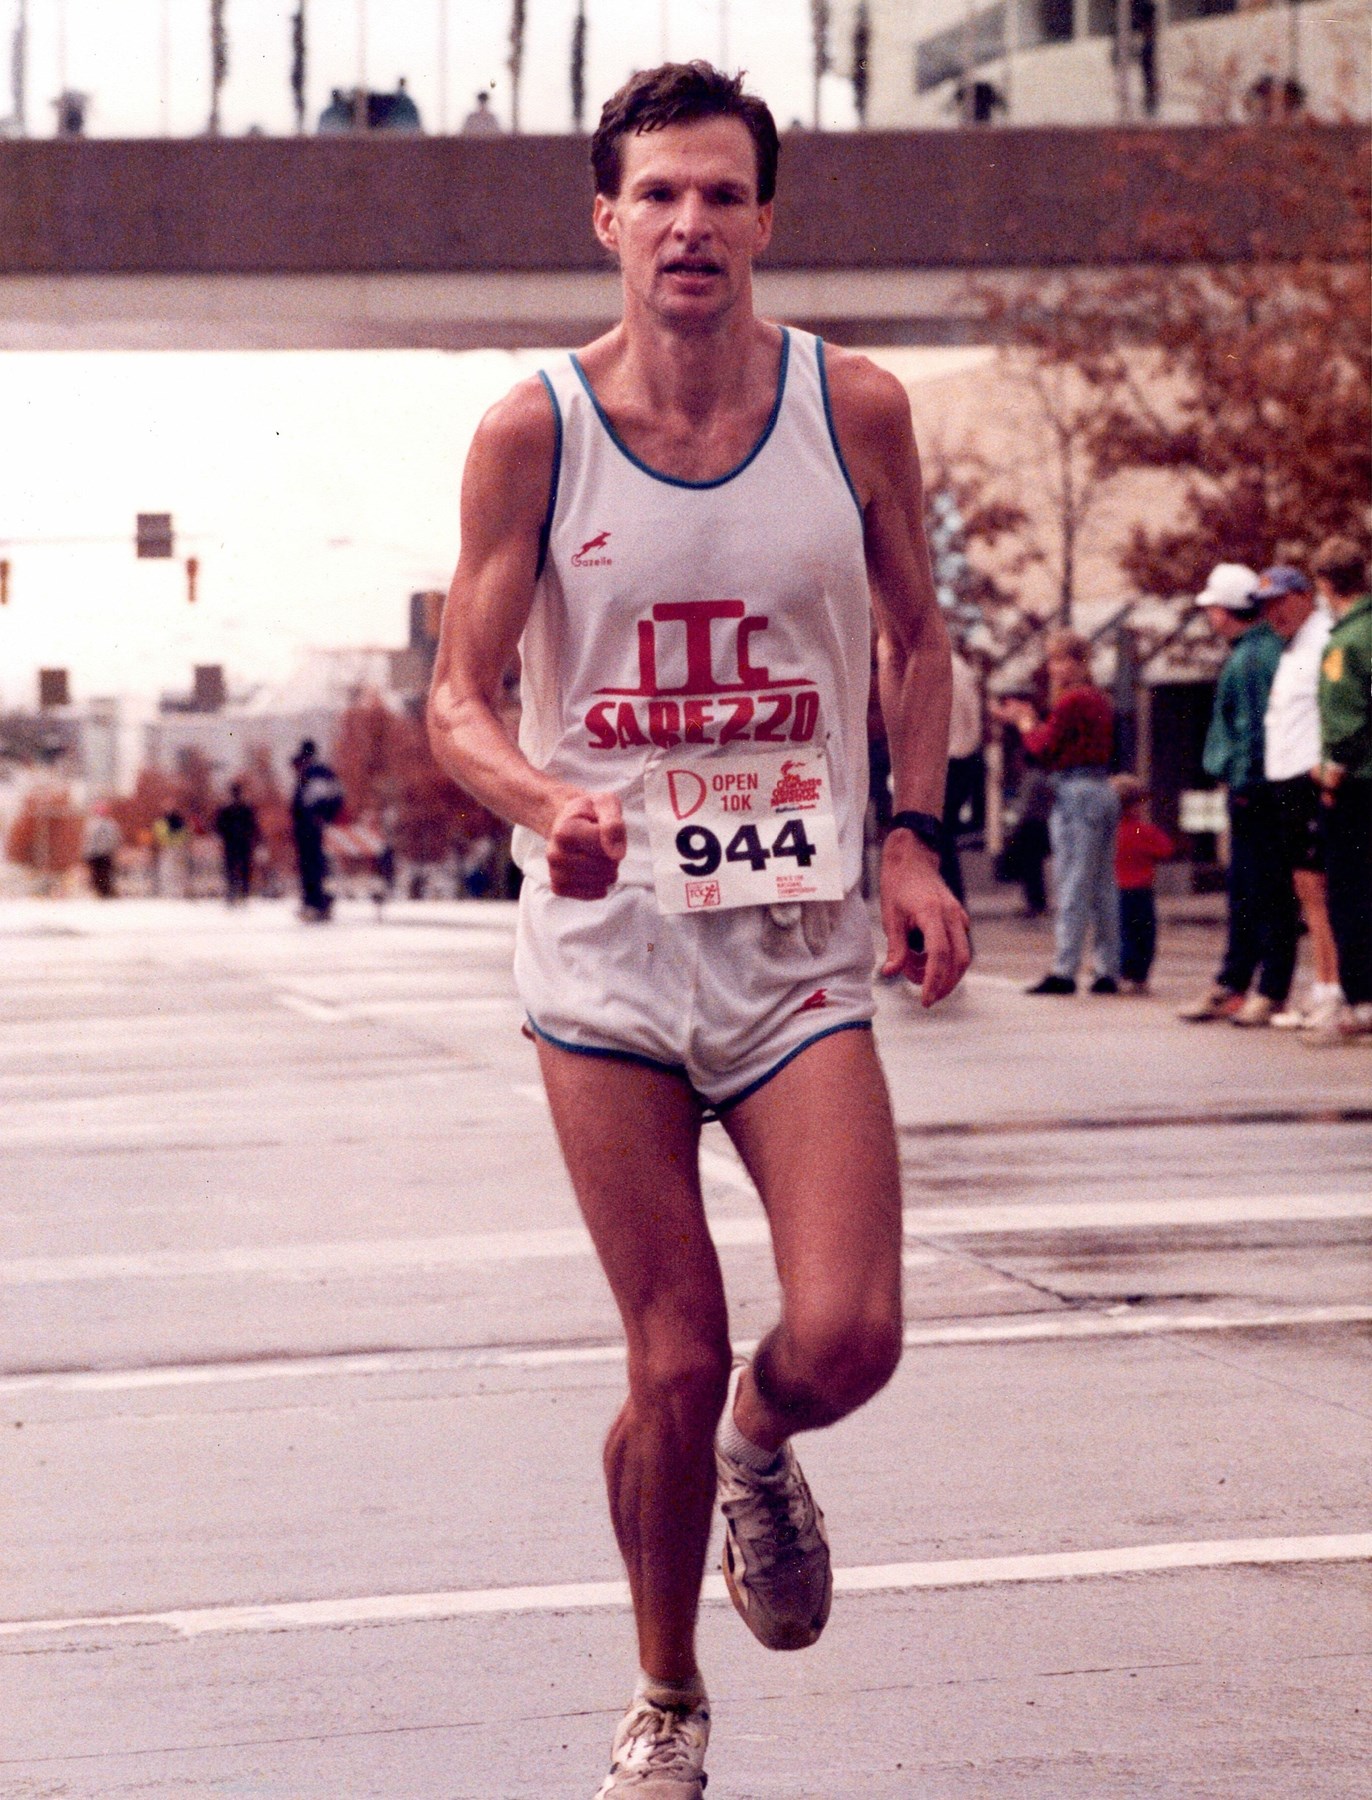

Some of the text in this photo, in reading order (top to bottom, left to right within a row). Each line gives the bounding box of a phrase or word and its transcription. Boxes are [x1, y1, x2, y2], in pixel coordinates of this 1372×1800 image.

[571, 554, 612, 567] Gazelle
[712, 773, 759, 792] OPEN
[720, 794, 752, 812] 10K
[675, 819, 817, 877] 944
